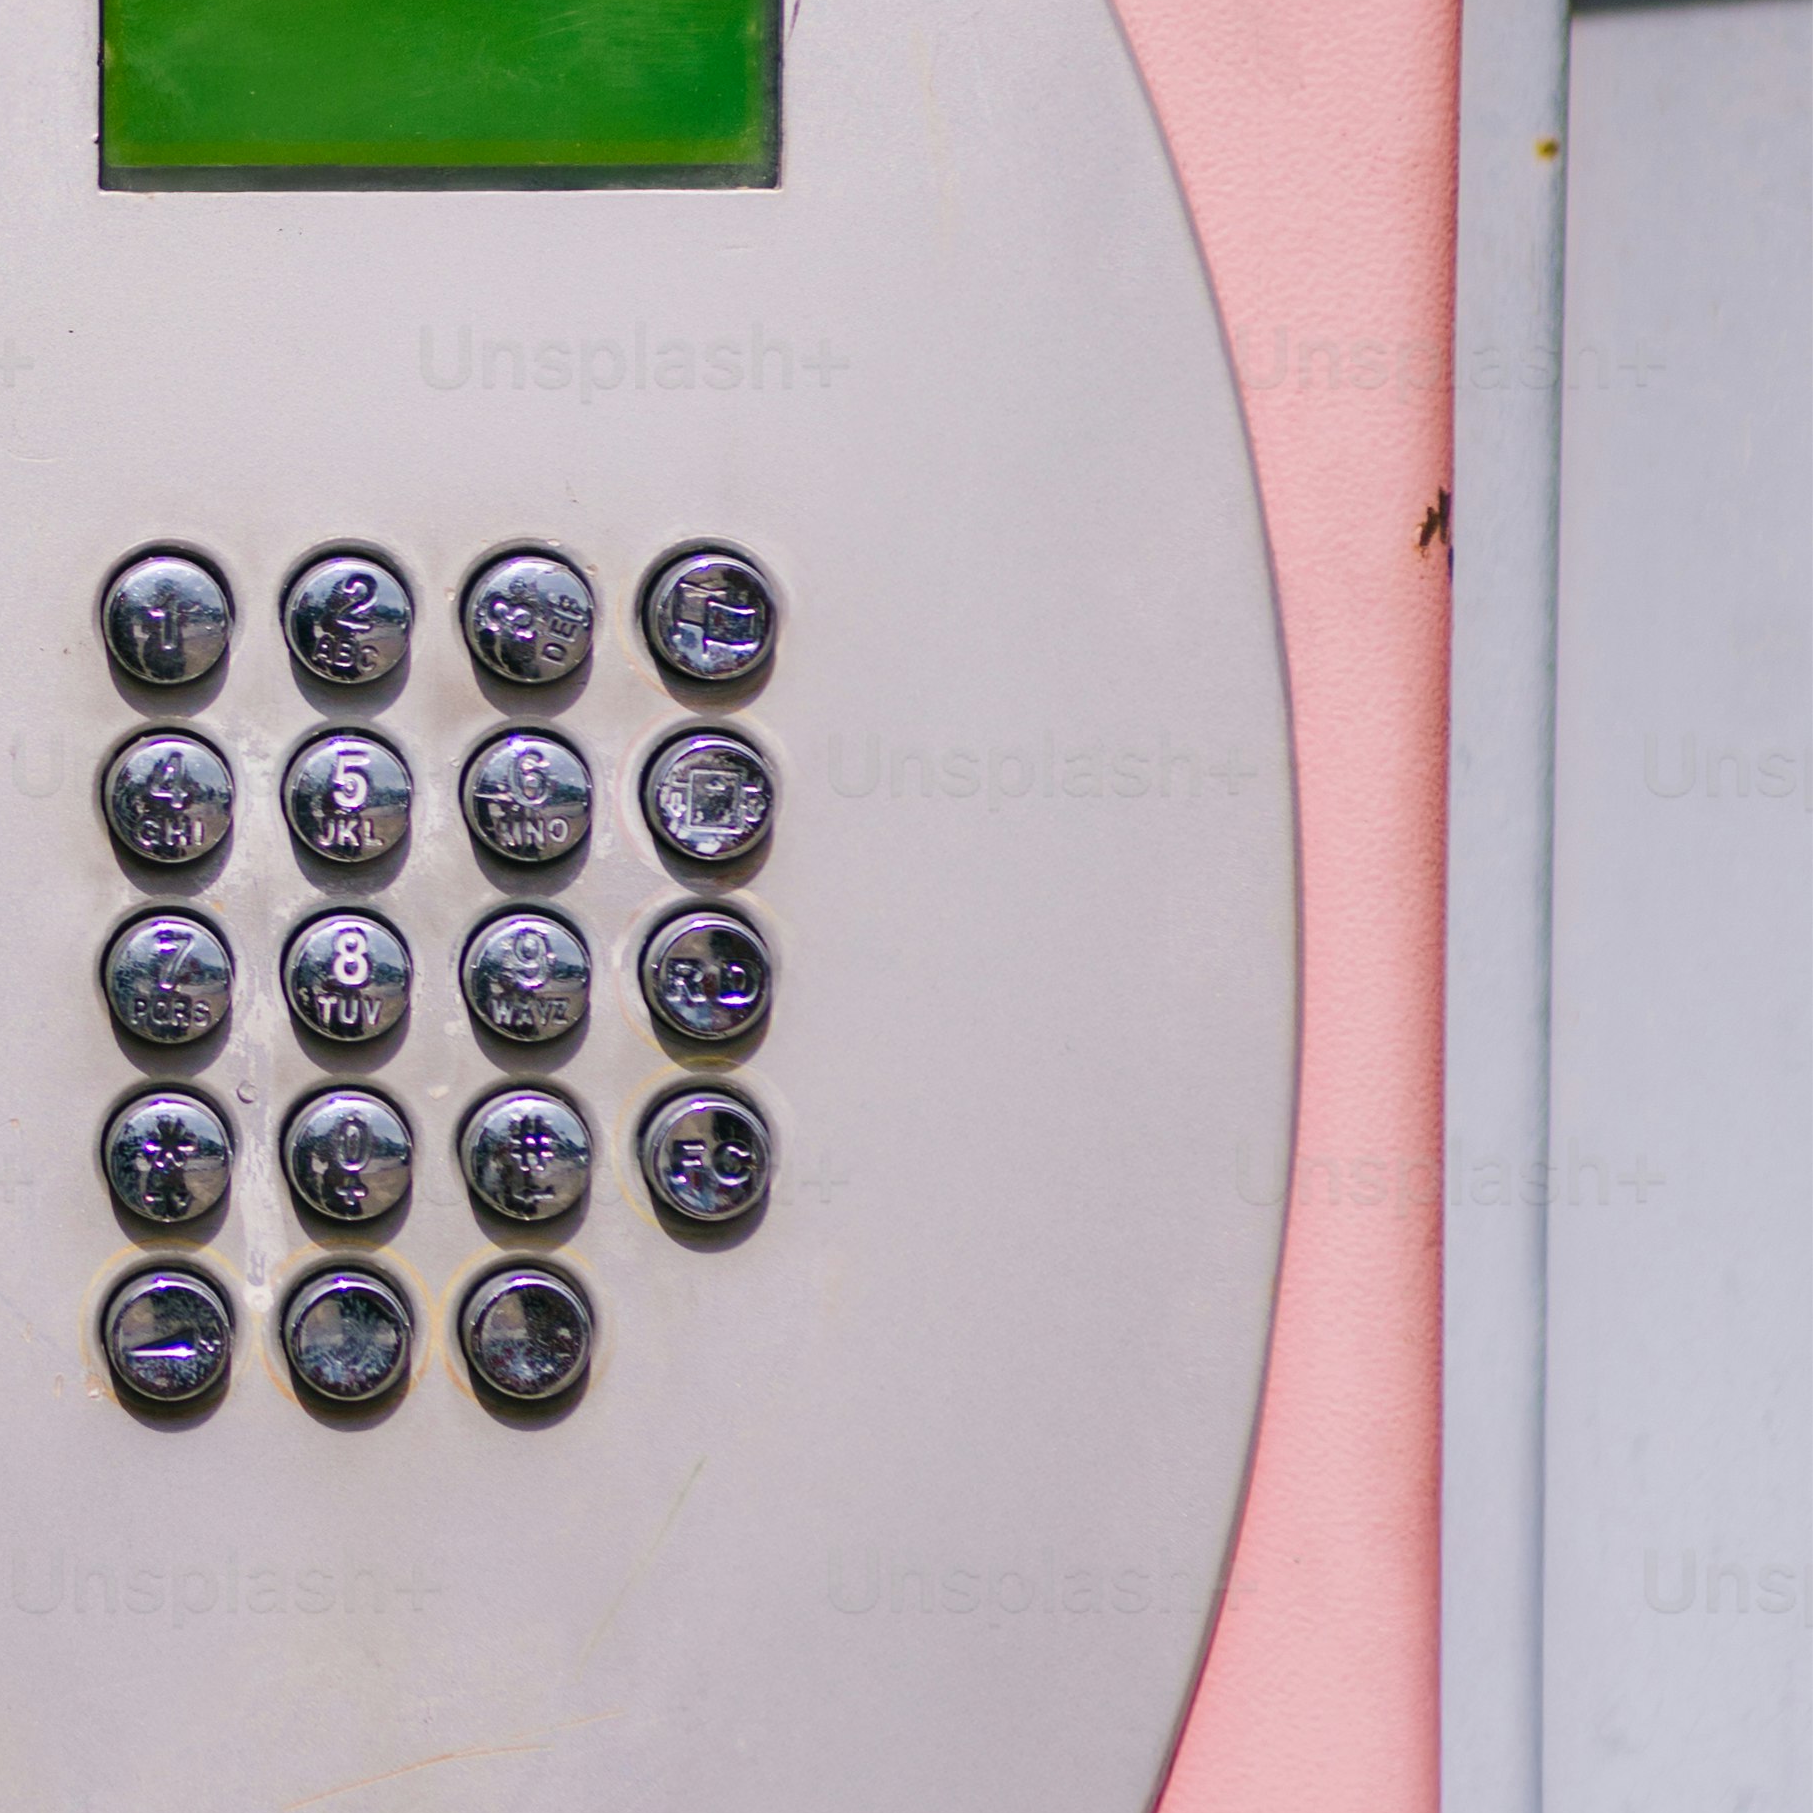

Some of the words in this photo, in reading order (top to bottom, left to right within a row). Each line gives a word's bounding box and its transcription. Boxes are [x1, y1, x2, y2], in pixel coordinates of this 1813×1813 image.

[334, 573, 378, 630] 2
[312, 636, 379, 671] ABC
[148, 752, 190, 808] 4
[332, 751, 372, 809] 5
[510, 750, 551, 808] 6
[137, 817, 203, 847] GHI
[317, 817, 384, 847] JKL
[154, 931, 195, 990] 7
[333, 928, 370, 987] 8
[512, 929, 550, 989] 9
[130, 999, 212, 1027] PQRS
[316, 995, 382, 1026] TUV
[336, 1117, 371, 1172] 0
